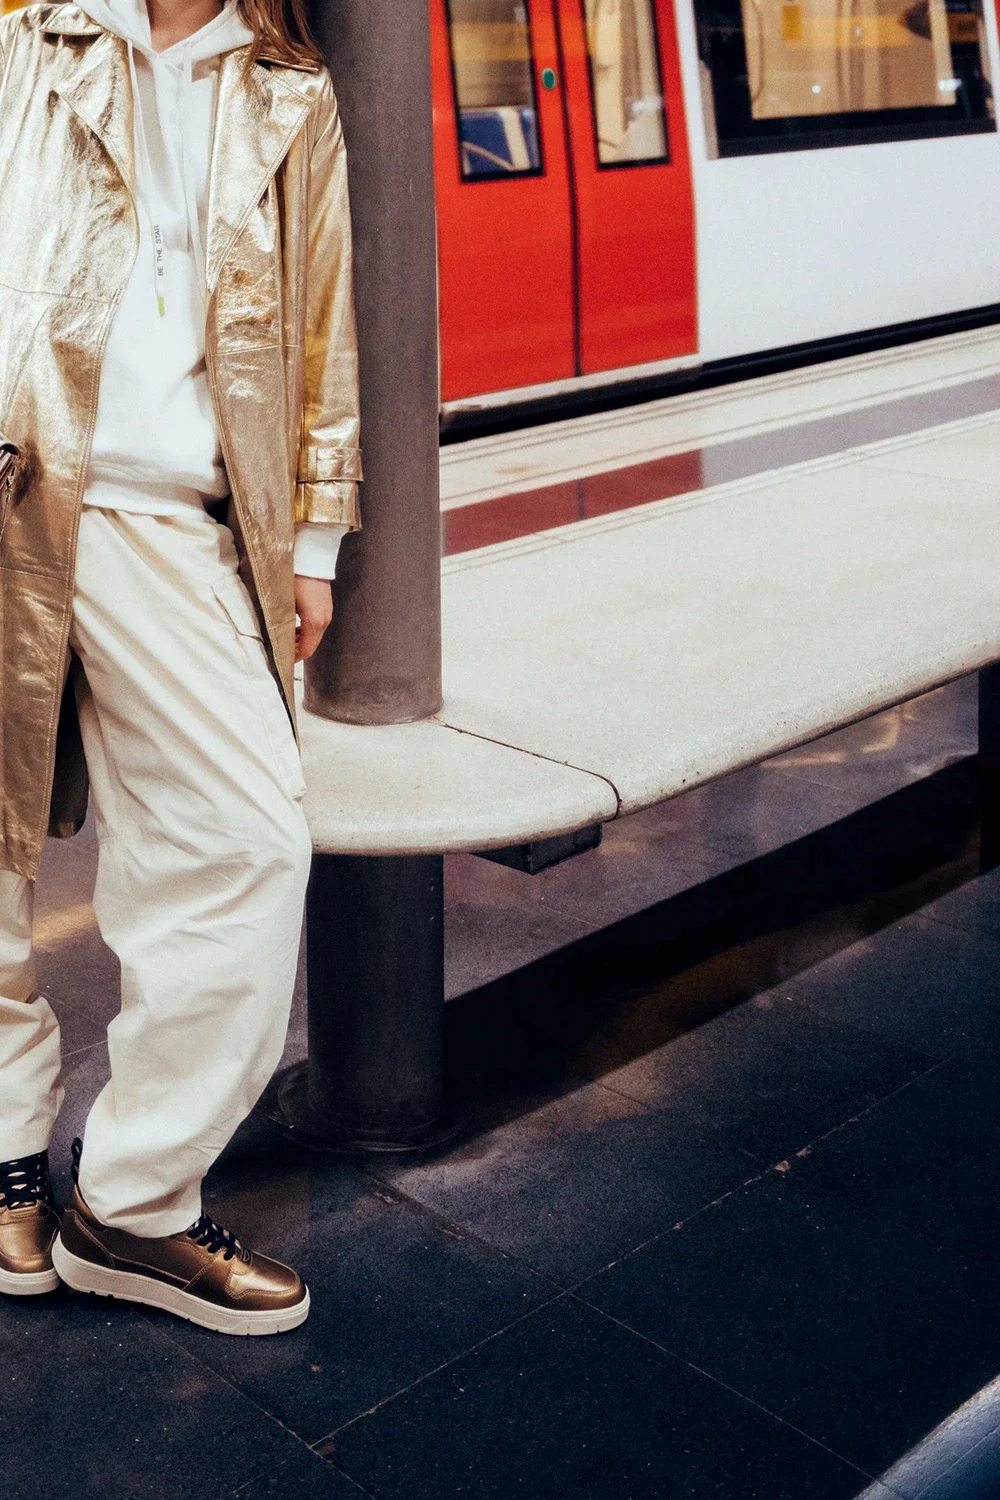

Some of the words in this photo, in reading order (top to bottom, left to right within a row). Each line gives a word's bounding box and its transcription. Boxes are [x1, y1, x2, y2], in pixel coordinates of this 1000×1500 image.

[153, 224, 162, 244] STAR
[155, 247, 163, 262] THE
[157, 265, 164, 276] BE
